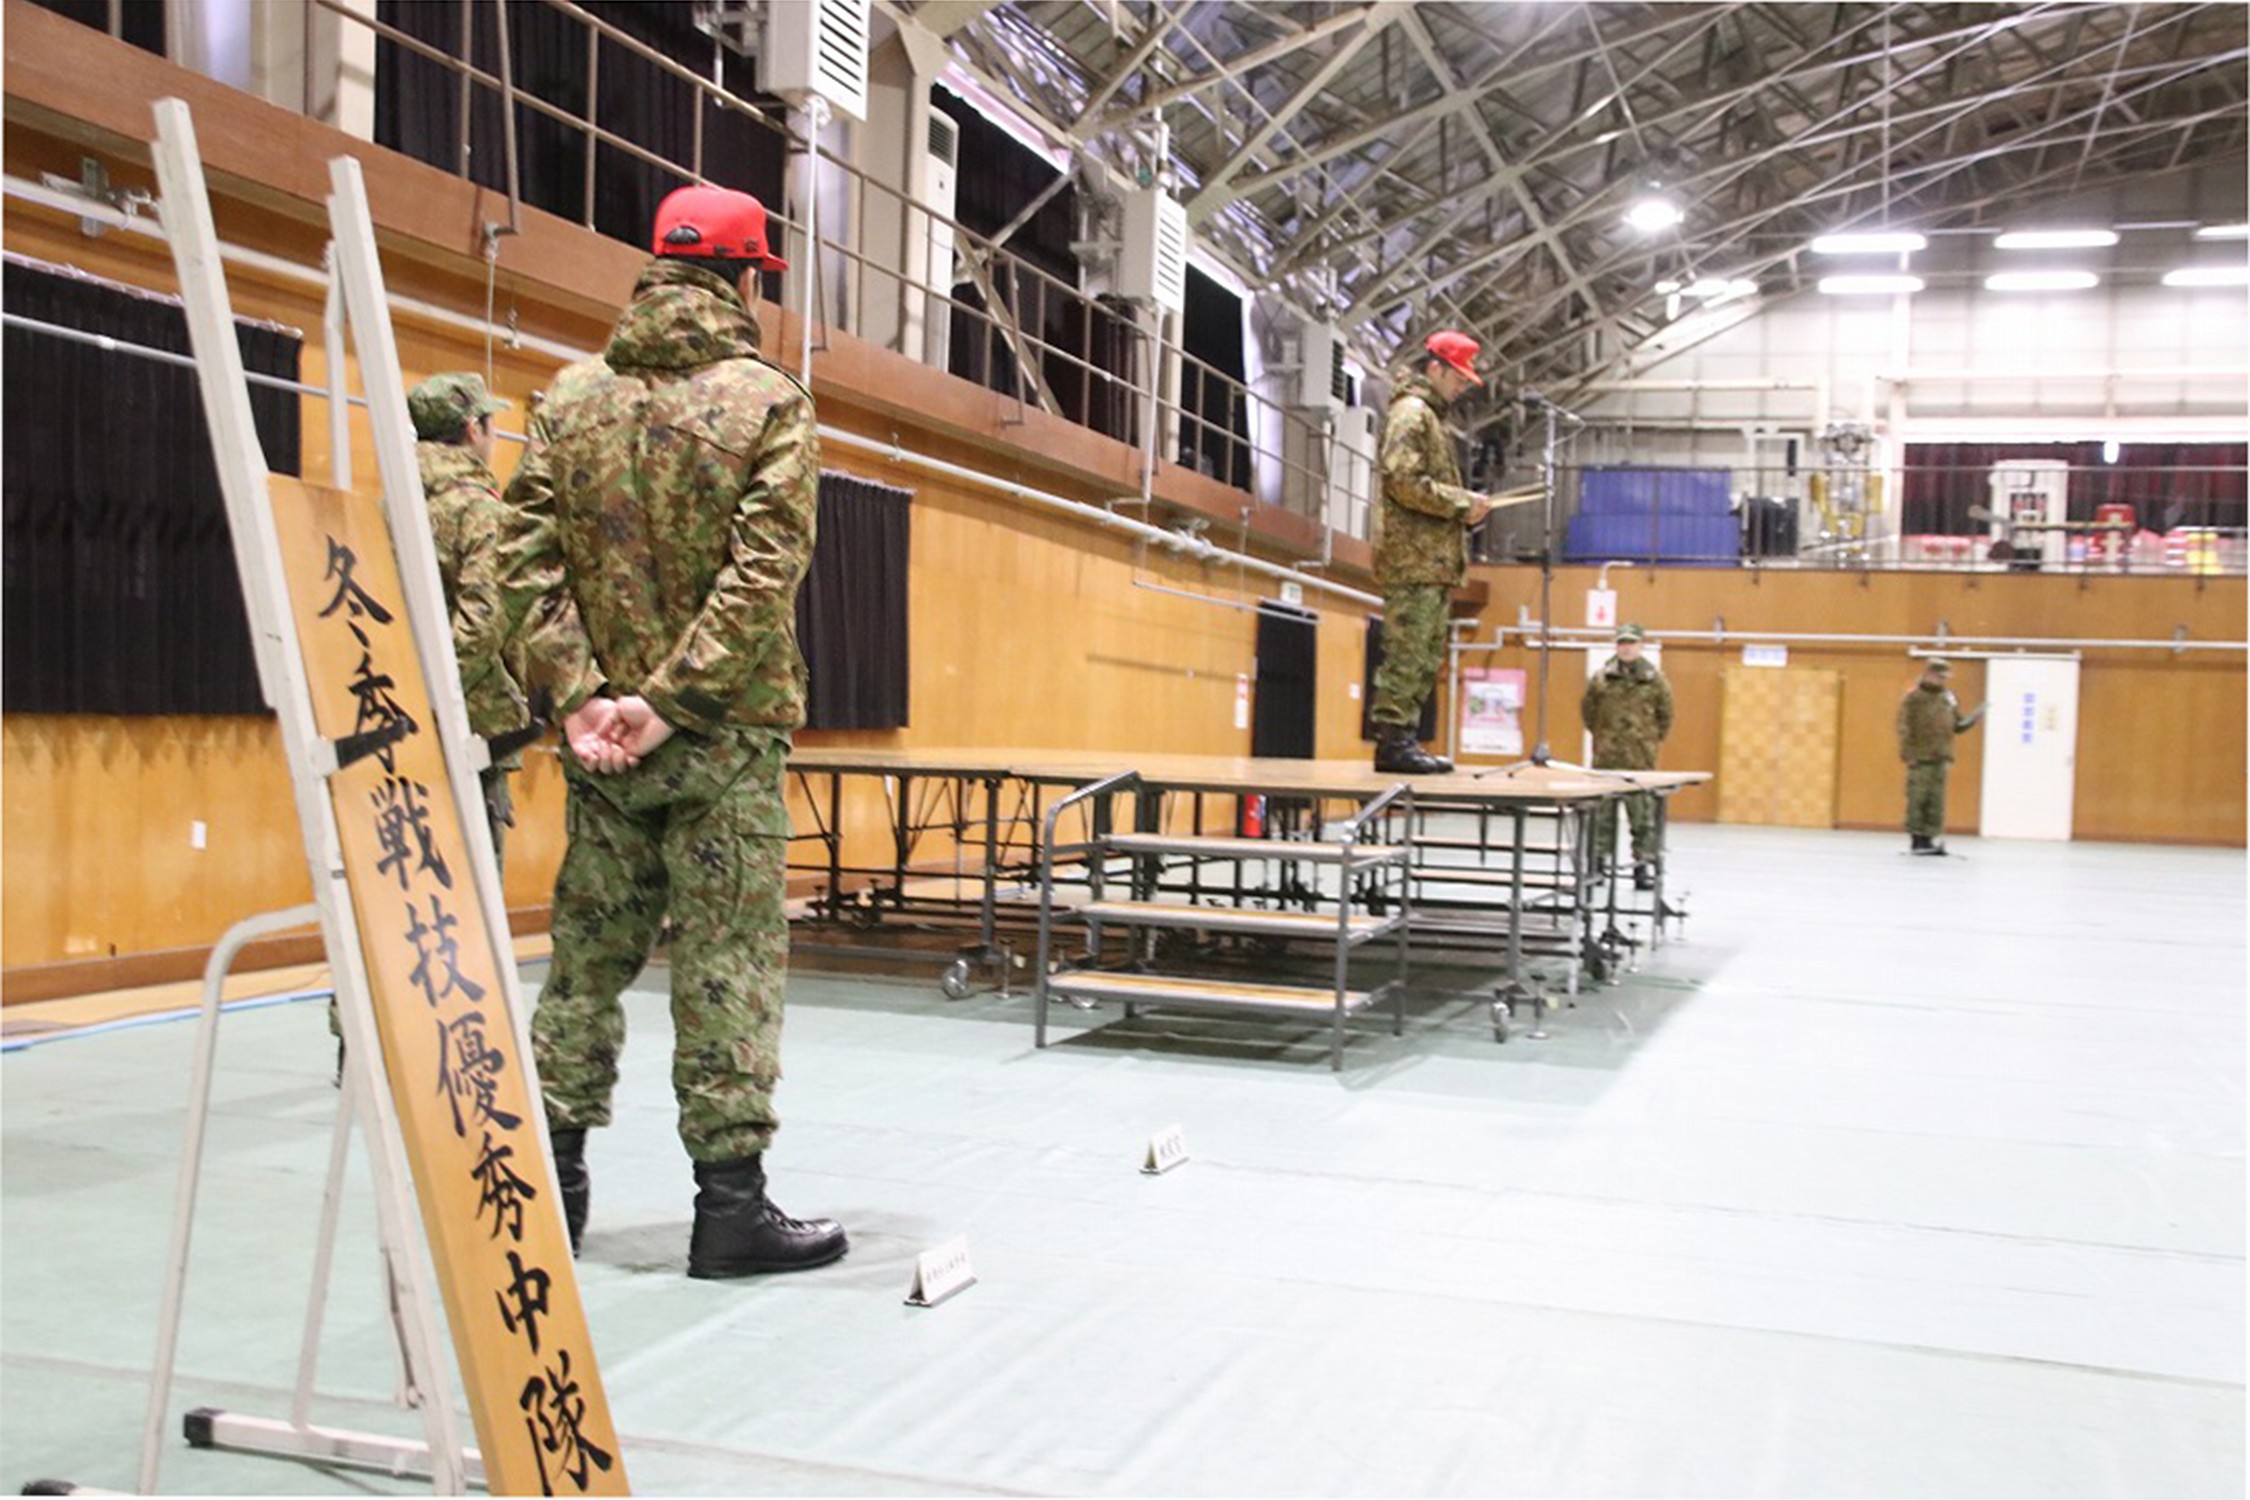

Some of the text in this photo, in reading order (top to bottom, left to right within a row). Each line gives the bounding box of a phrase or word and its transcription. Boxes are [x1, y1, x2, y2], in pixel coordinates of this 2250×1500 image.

[317, 534, 613, 1496] 冬季戦技優秀中隊
